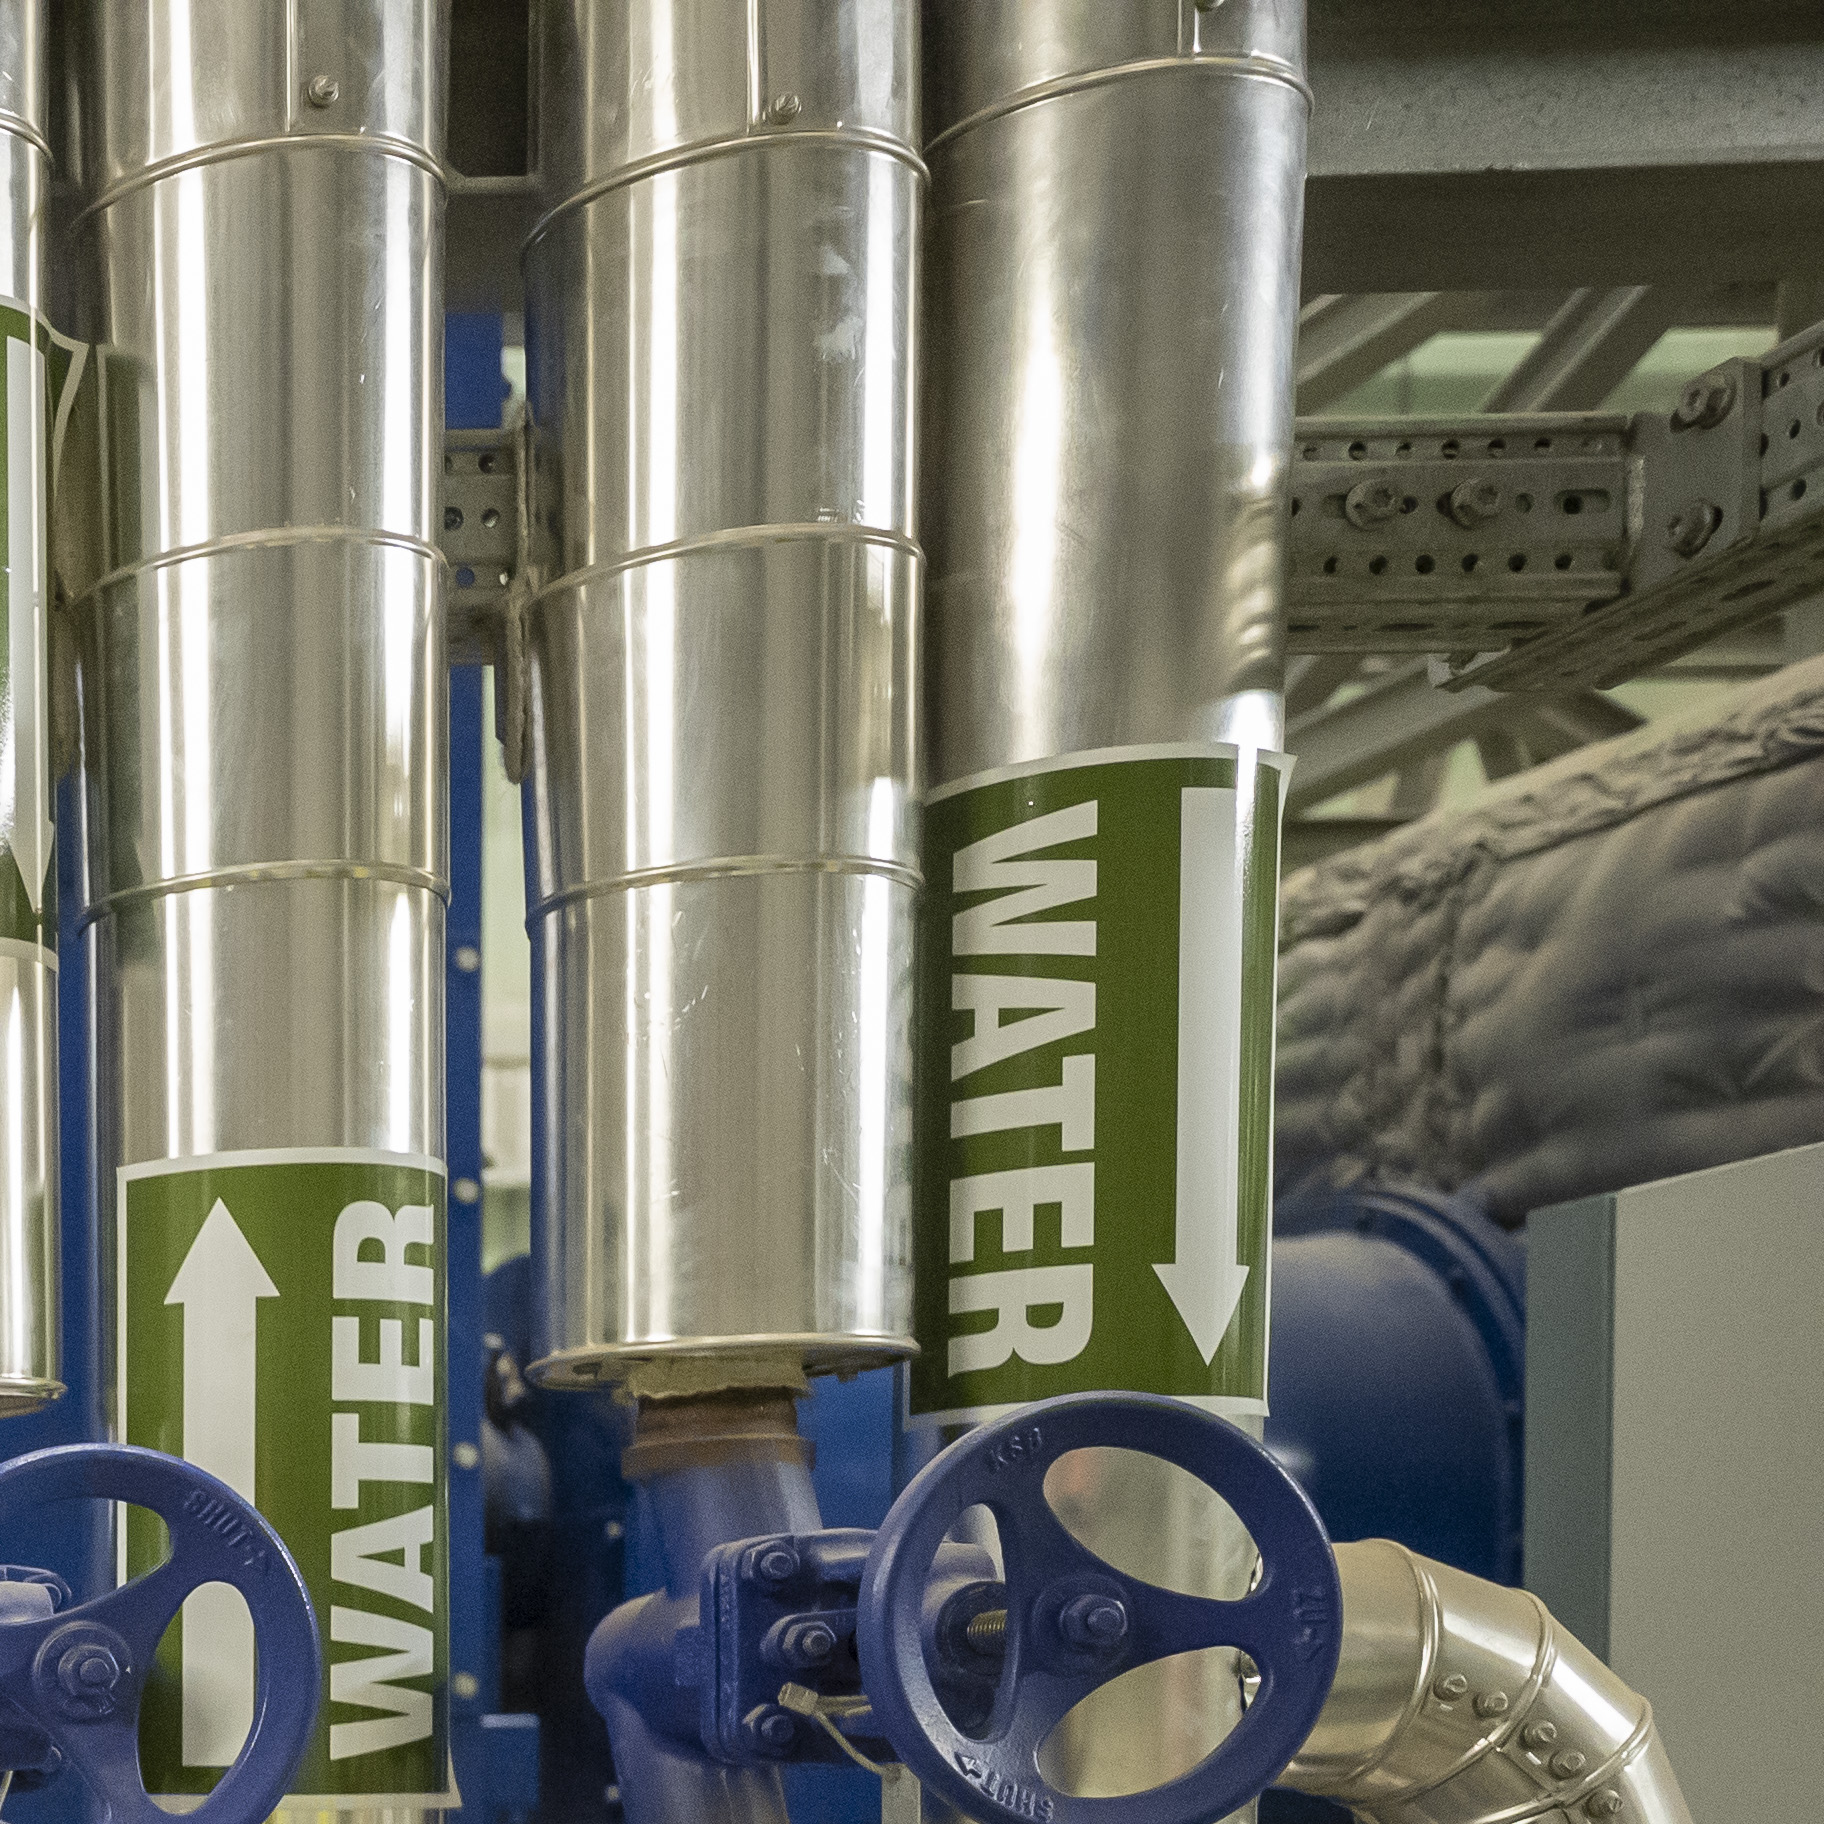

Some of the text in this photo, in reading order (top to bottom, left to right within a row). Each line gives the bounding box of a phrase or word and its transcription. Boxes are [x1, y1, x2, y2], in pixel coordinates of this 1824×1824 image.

[948, 800, 1098, 1378] WATER
[330, 1200, 434, 1761] WATER
[980, 1769, 1054, 1823] SHUT
